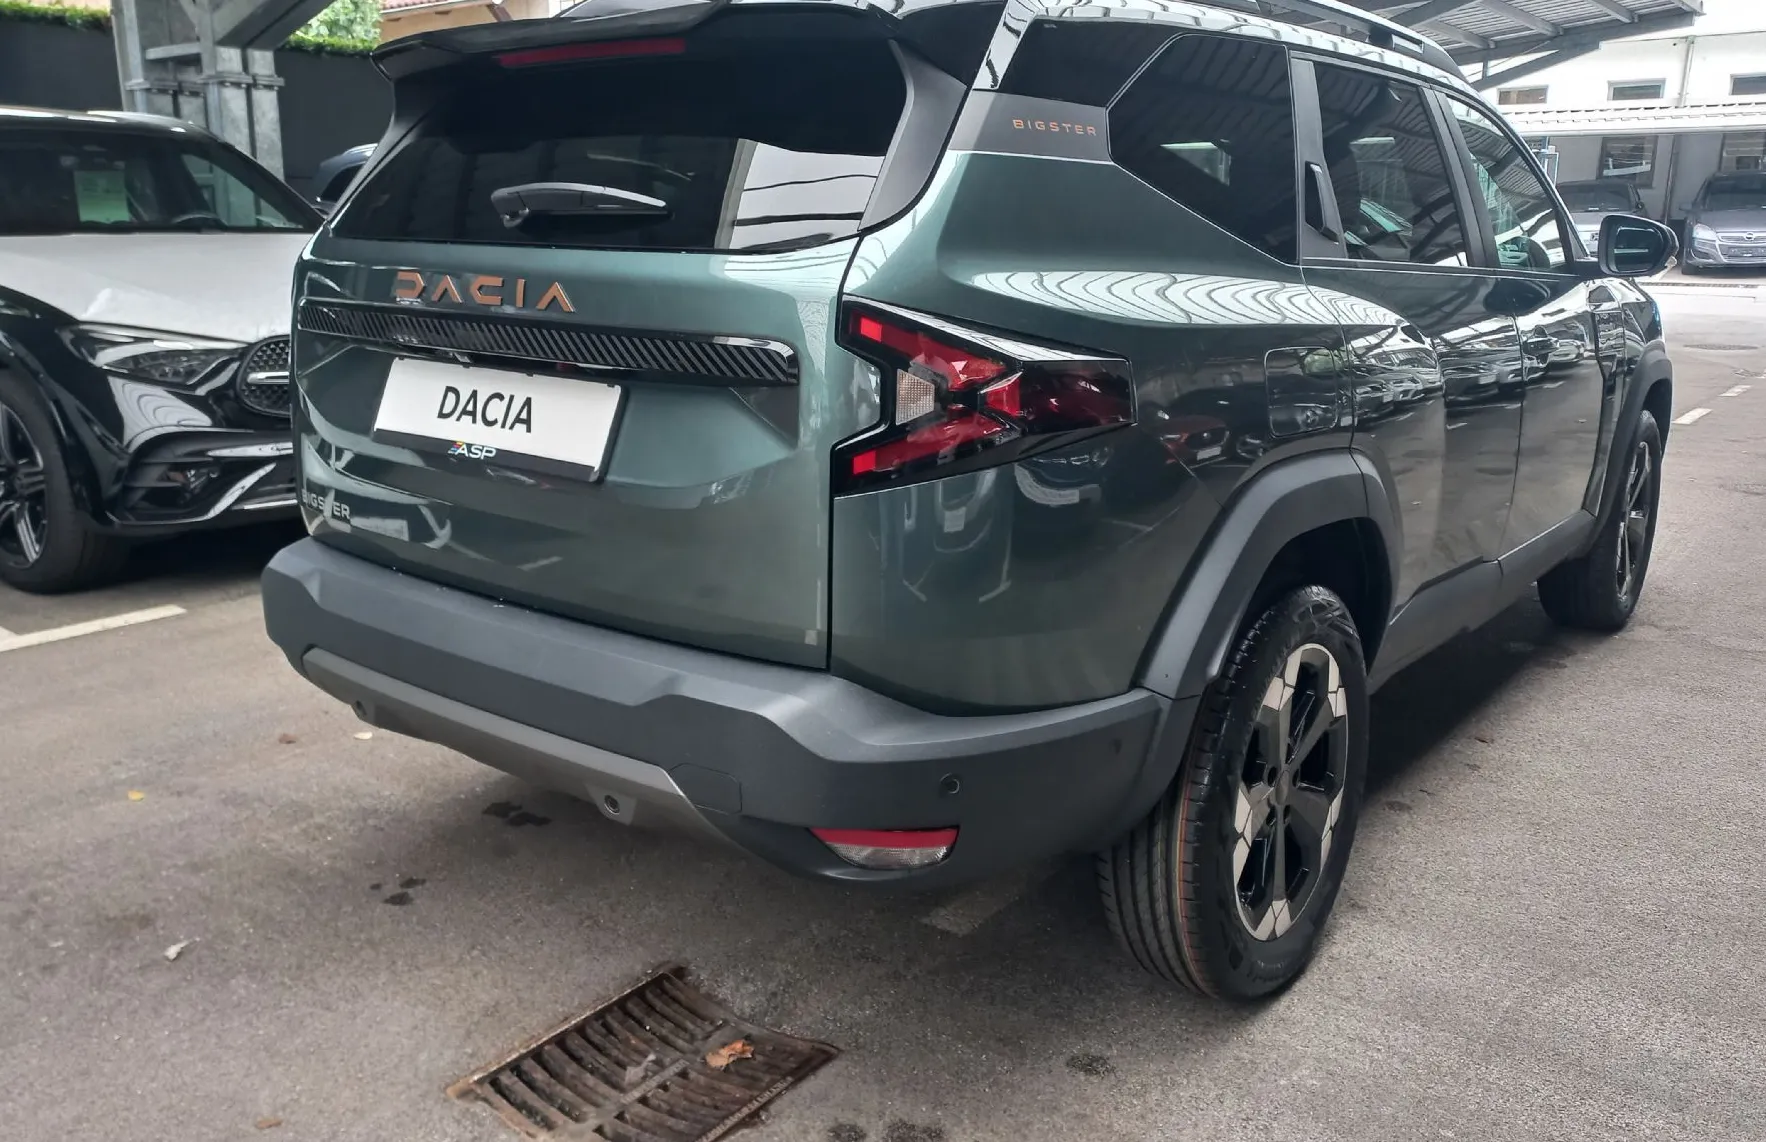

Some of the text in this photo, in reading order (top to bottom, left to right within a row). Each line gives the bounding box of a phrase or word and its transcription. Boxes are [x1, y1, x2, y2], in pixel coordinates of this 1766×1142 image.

[1012, 119, 1097, 136] BIGSTER
[395, 270, 577, 313] DACIA
[436, 385, 532, 434] DACIA
[455, 442, 497, 460] ASP
[301, 488, 351, 520] BIGSER
